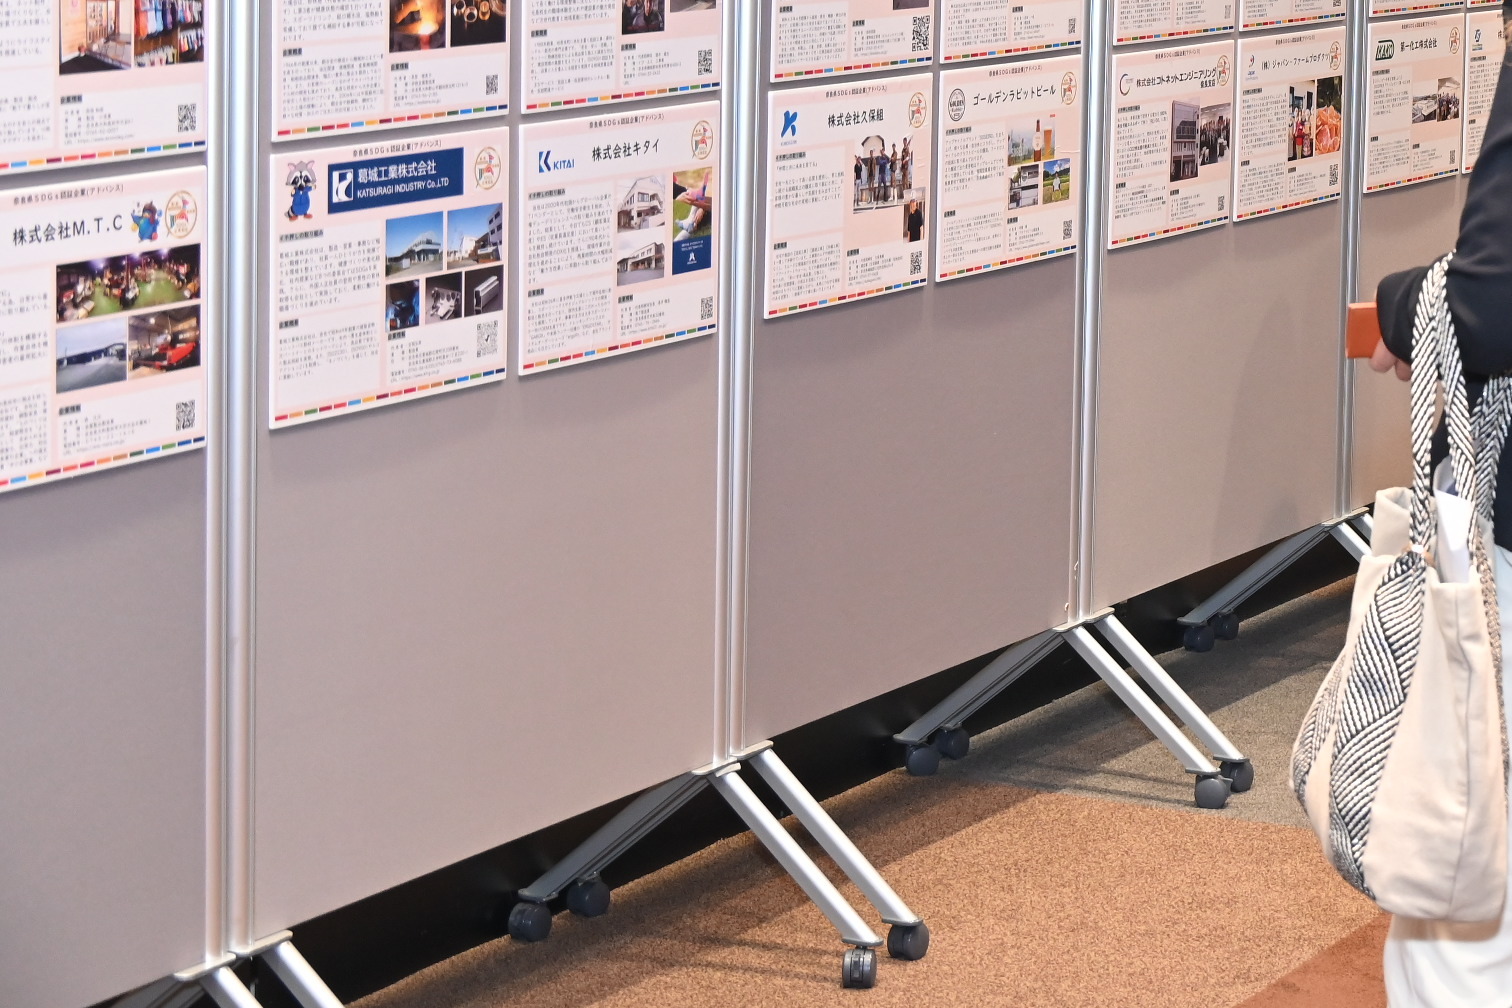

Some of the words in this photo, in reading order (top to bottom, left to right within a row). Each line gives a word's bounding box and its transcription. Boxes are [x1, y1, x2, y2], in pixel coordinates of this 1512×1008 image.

[1136, 66, 1217, 88] 株式会社コトネットエンジニアリング
[973, 84, 1056, 106] ゴールデンラビットビール
[827, 108, 884, 129] 株式会社久保組
[592, 139, 660, 162] 株式会社キタイ
[357, 159, 437, 183] 葛城工業株式会社
[553, 158, 575, 171] KITAI
[357, 187, 394, 199] KATSURAGI
[394, 181, 427, 194] INDUSTRY
